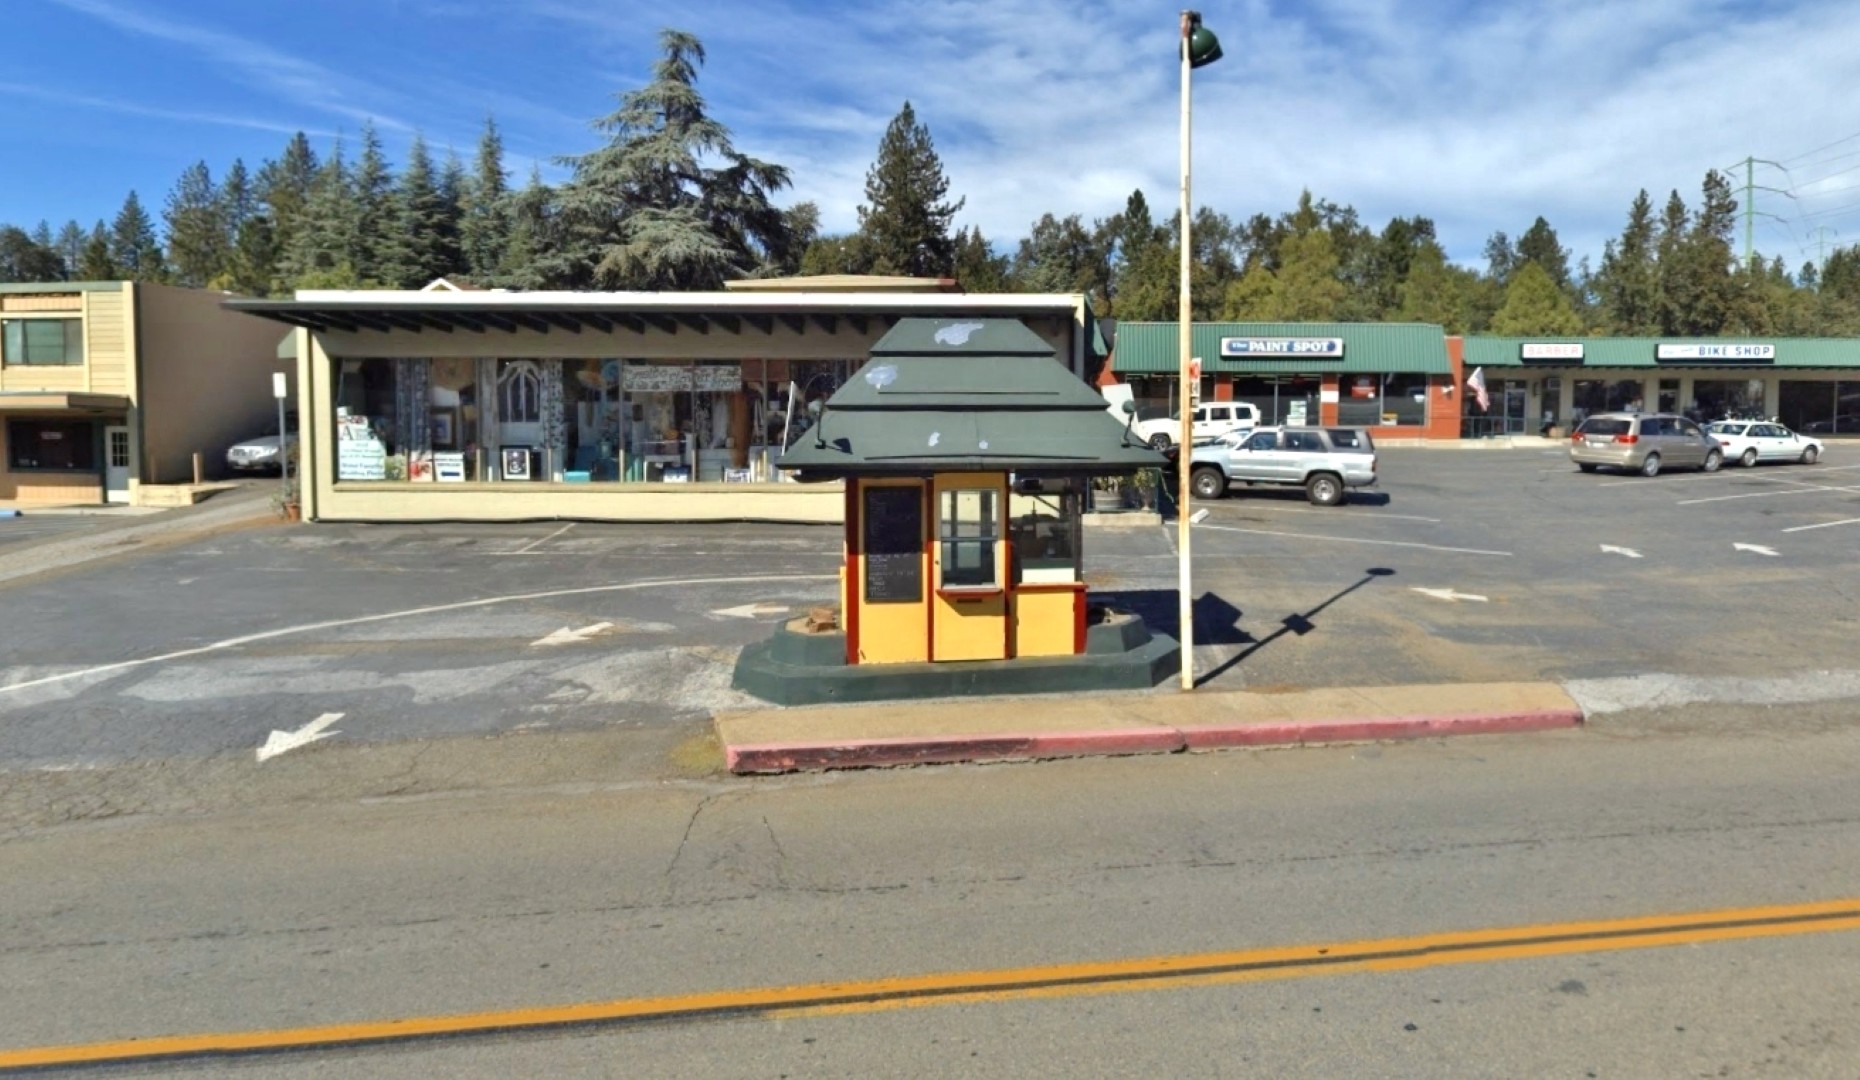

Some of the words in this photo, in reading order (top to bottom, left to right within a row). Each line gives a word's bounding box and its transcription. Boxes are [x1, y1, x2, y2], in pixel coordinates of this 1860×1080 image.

[1249, 340, 1288, 352] PAINT
[1293, 340, 1329, 352] SPOT
[1527, 345, 1579, 356] BARBER
[1699, 346, 1728, 356] BIKE
[1735, 346, 1770, 356] SHOP
